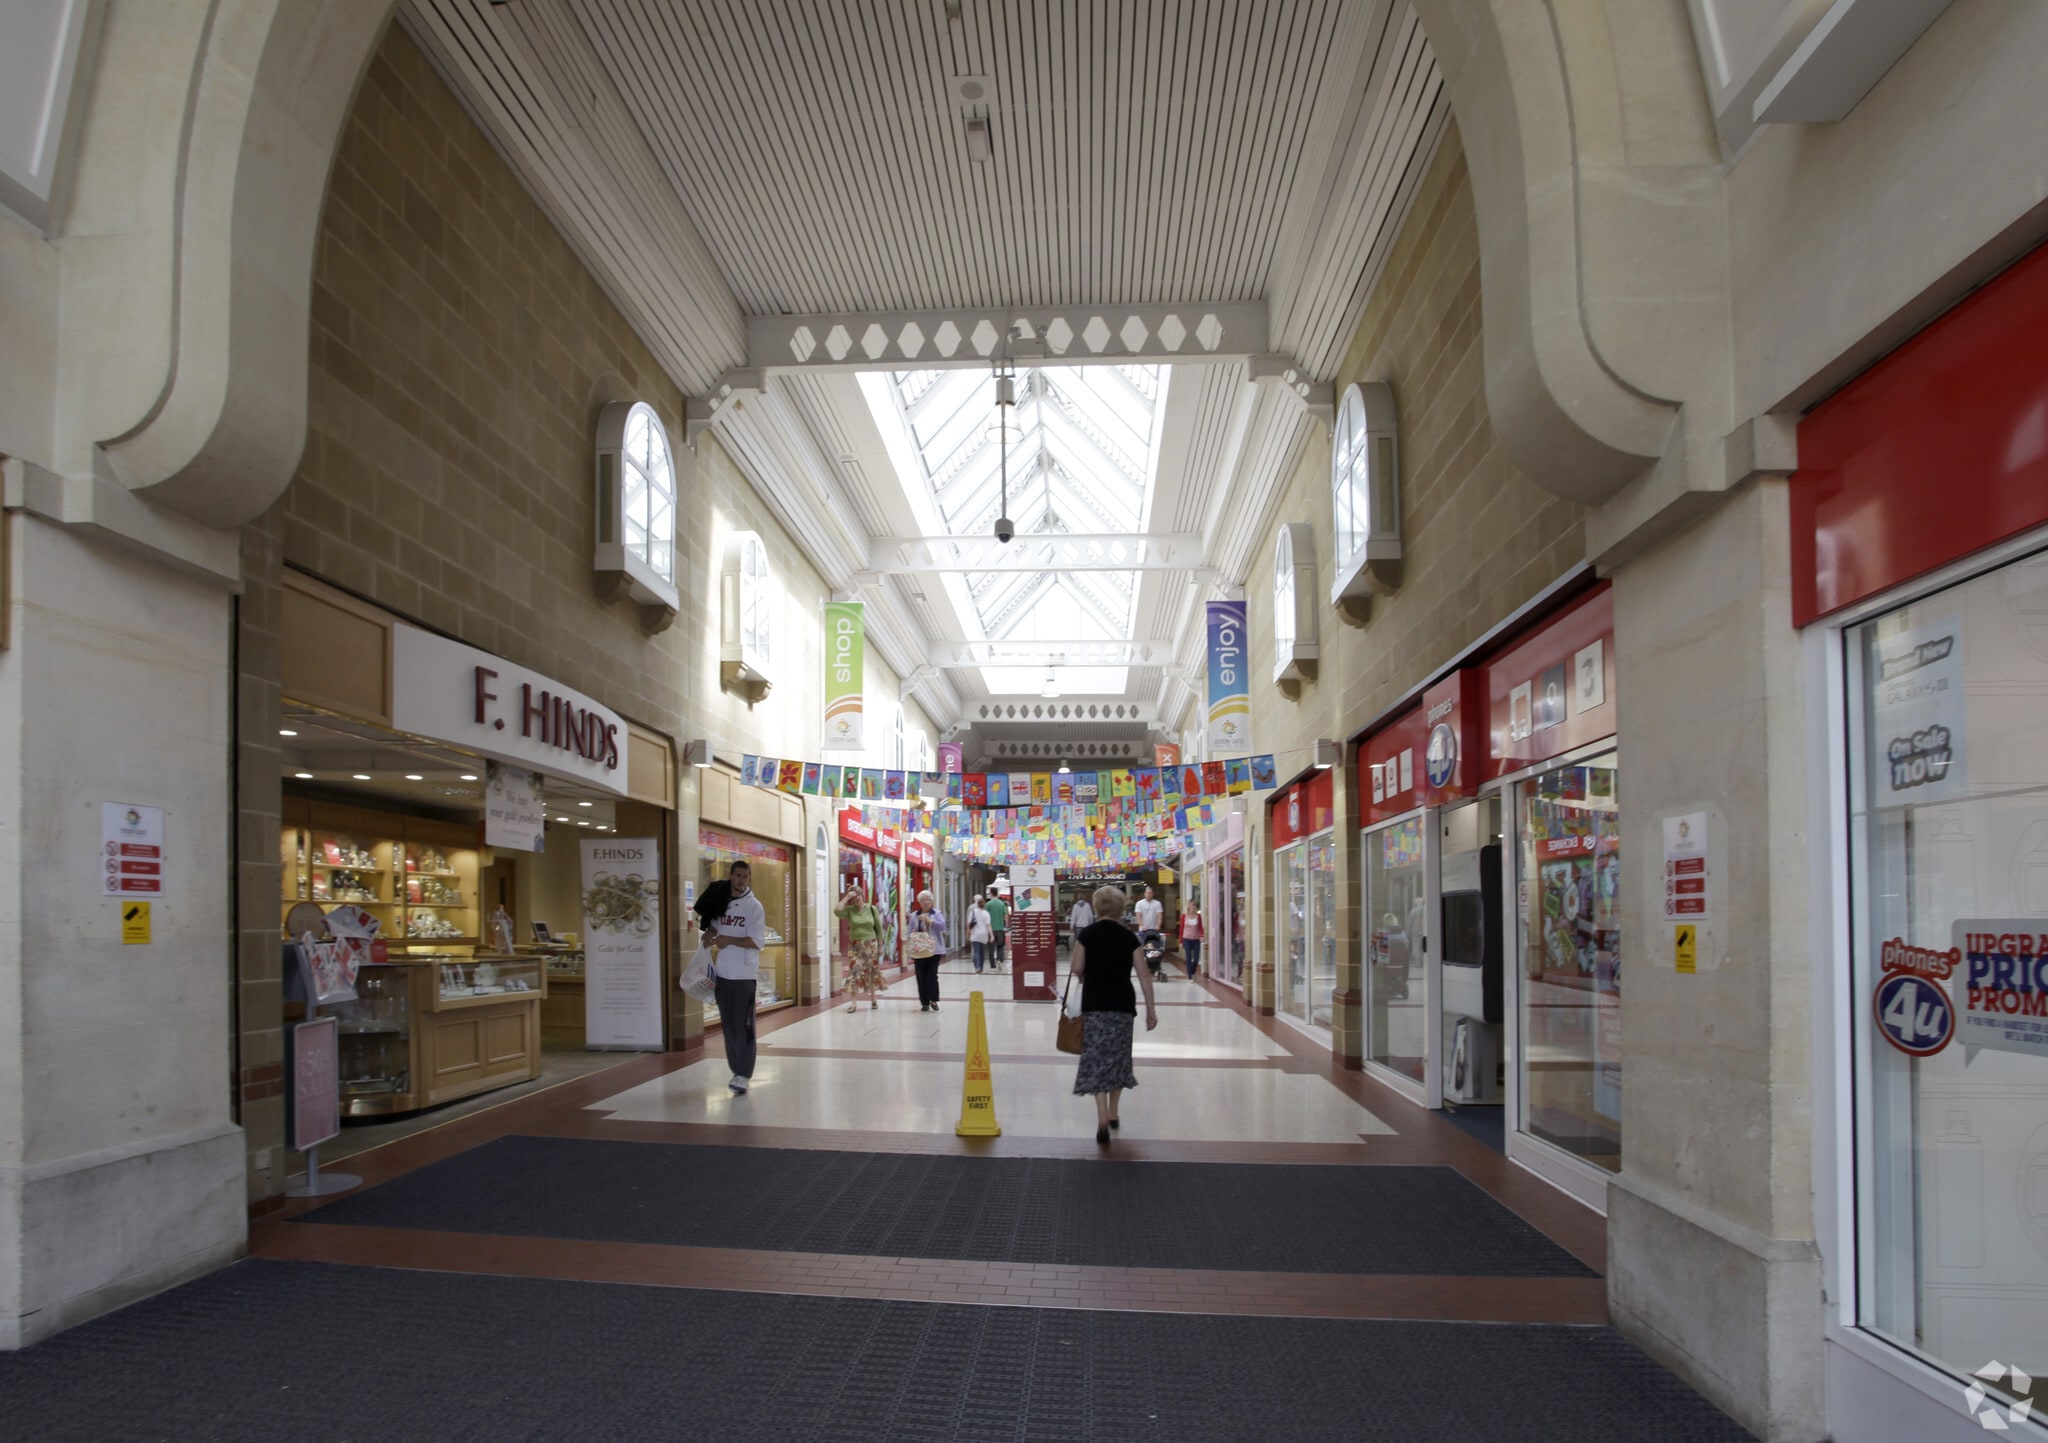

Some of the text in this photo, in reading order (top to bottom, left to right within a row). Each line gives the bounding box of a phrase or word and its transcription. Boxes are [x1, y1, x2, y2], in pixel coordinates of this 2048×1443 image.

[833, 617, 855, 683] shop
[1216, 614, 1239, 685] enjoy
[474, 666, 618, 769] F. HINDS
[1891, 727, 1947, 760] On Sale
[1893, 752, 1949, 785] now
[593, 848, 643, 860] F.HINDS
[598, 944, 643, 955] Gold for Cash
[1884, 943, 1949, 975] phones
[1884, 981, 1945, 1042] 4u
[966, 1095, 991, 1103] SAFETY
[968, 1102, 988, 1110] FIRST
